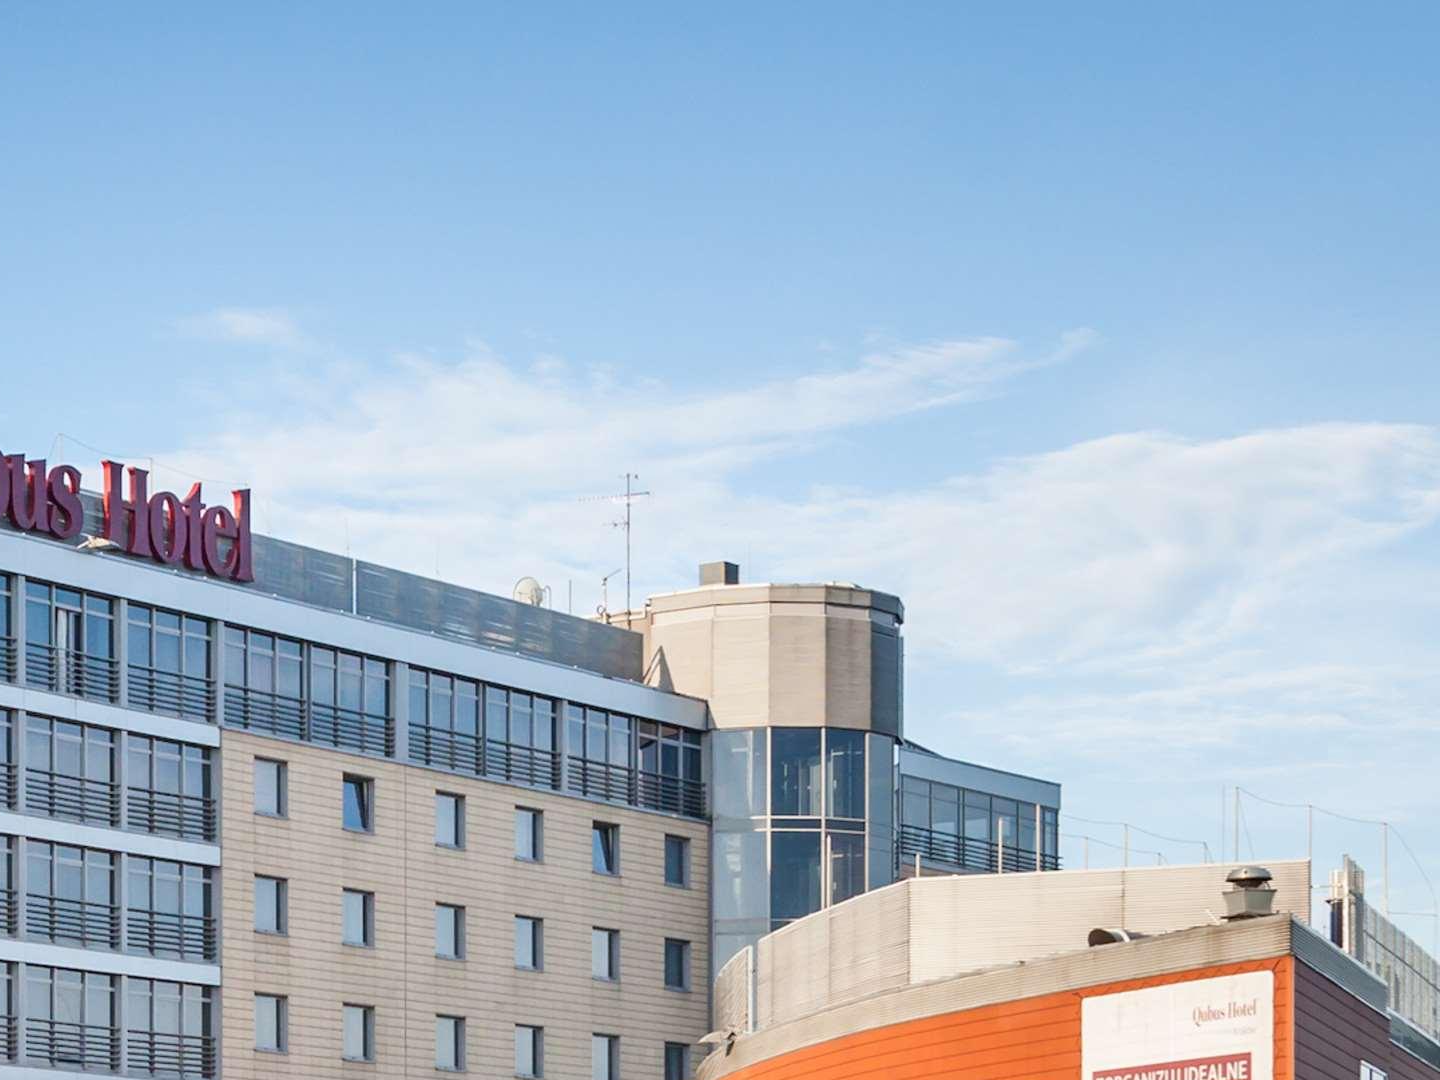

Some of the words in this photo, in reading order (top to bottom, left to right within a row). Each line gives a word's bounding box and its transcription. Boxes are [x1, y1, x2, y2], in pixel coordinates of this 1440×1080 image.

[101, 458, 254, 583] Hotel
[1192, 1004, 1225, 1028] Qubus
[1228, 998, 1257, 1018] Hotel
